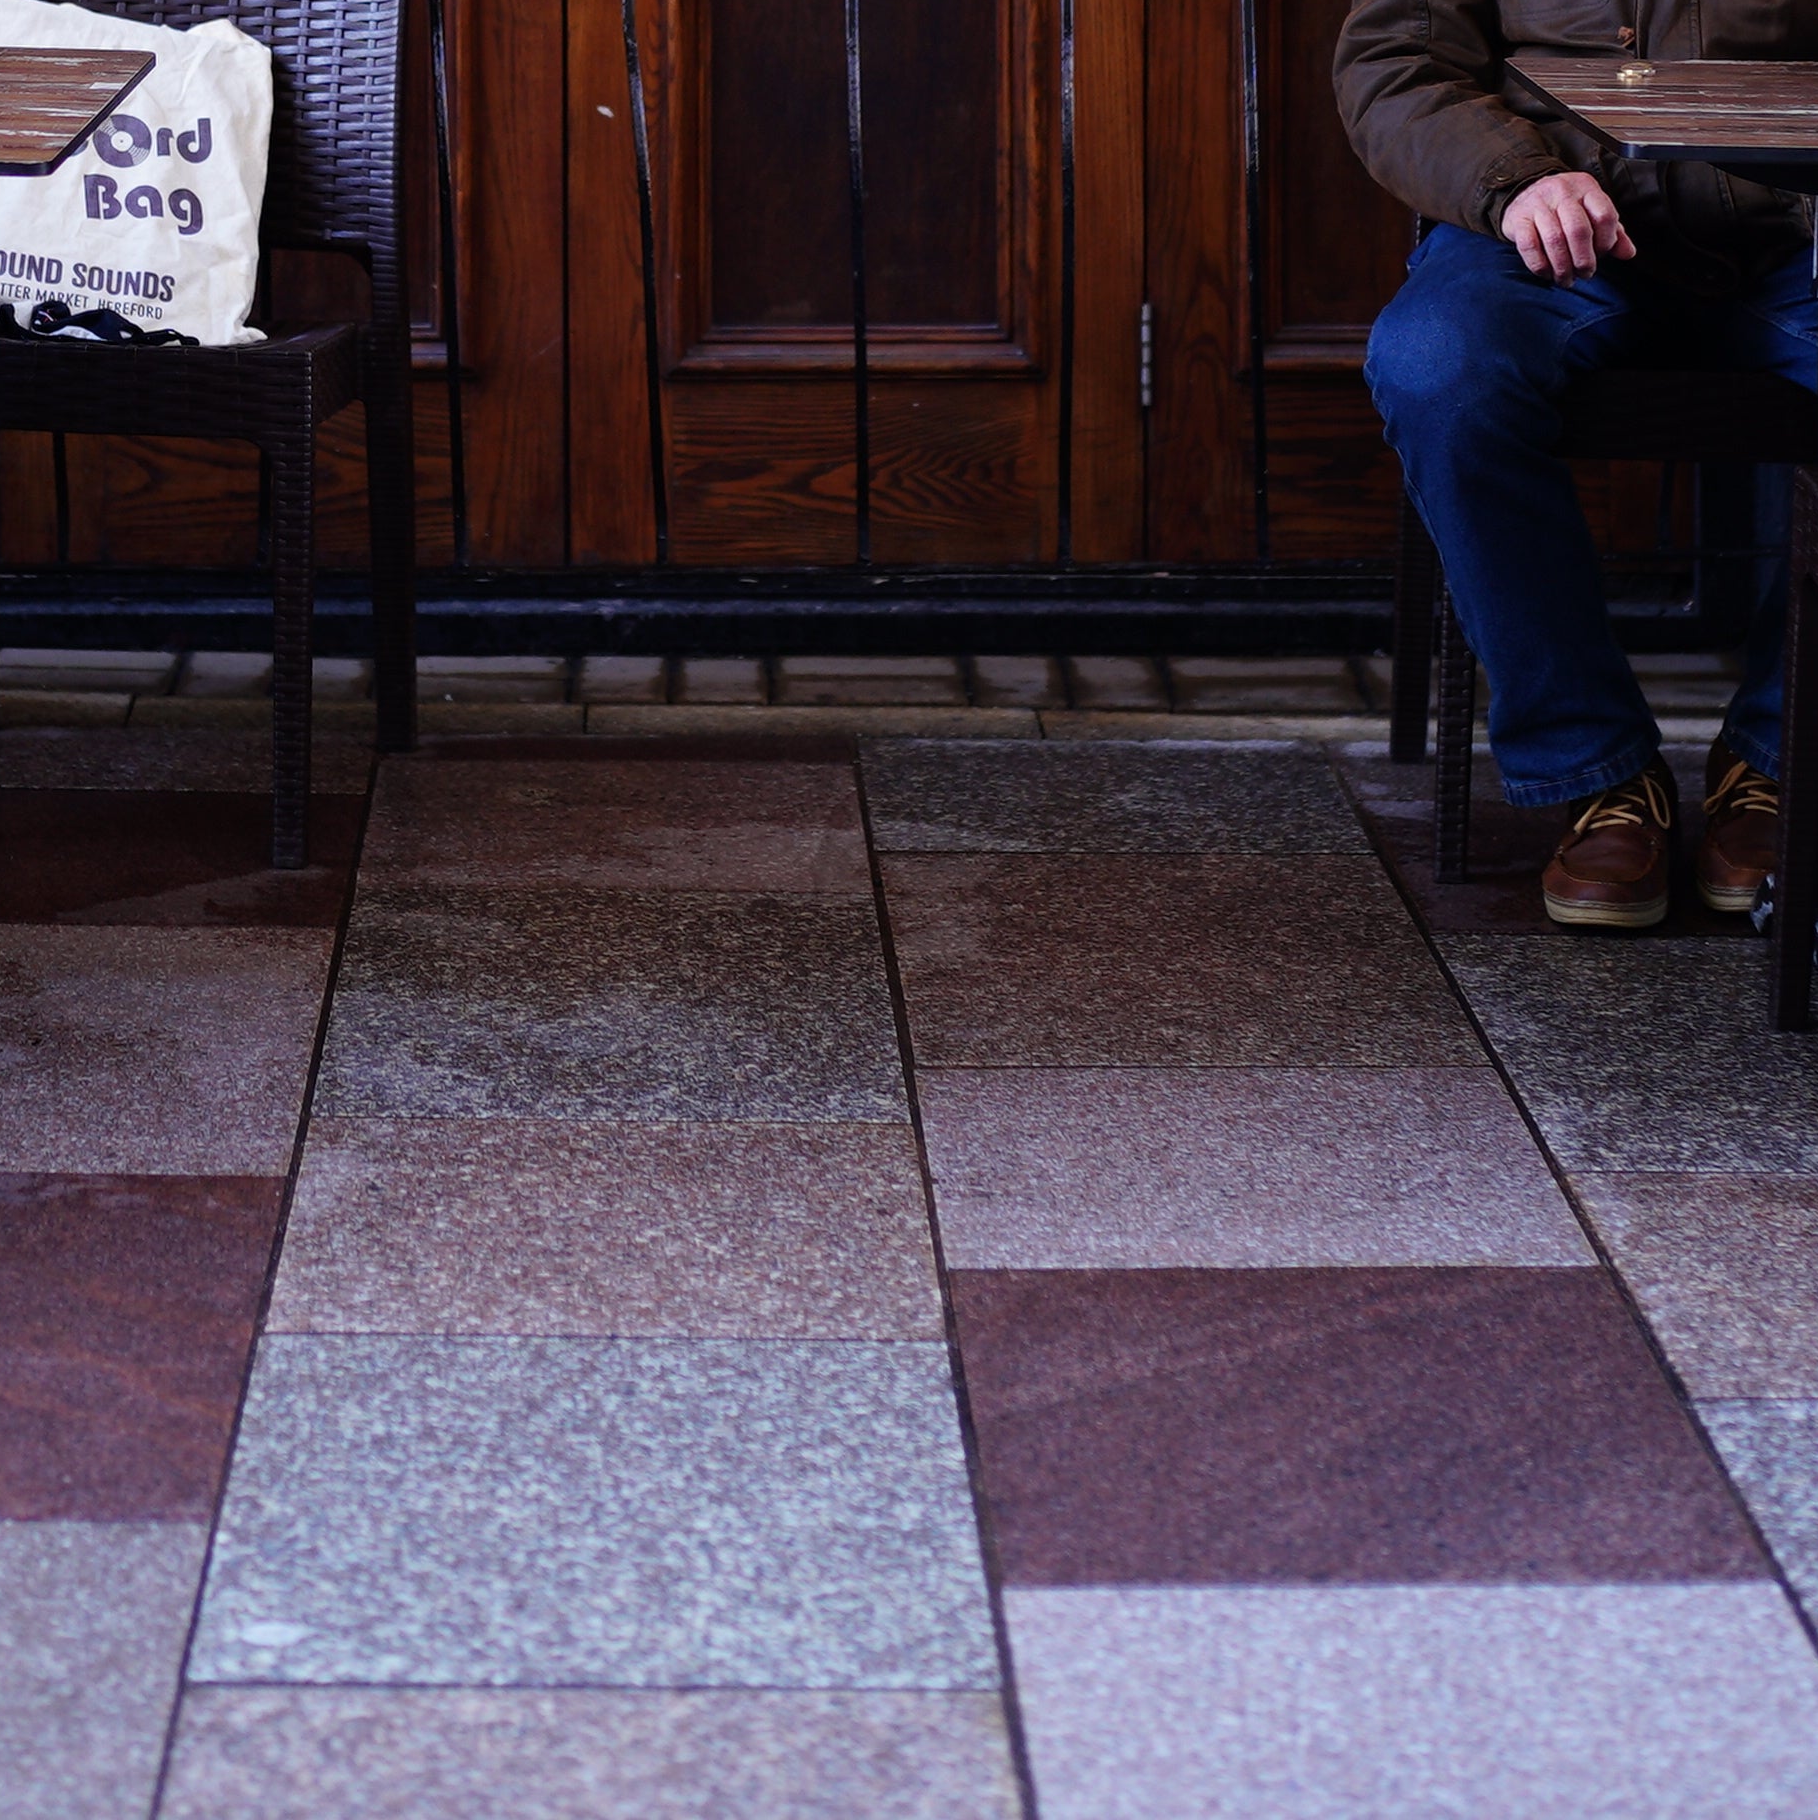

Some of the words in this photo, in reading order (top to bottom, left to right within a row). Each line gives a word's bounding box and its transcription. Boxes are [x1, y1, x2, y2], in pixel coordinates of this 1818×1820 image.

[83, 173, 204, 236] Bag
[71, 263, 176, 303] SOUNDS
[35, 288, 90, 309] MARKET
[97, 299, 163, 321] HEREFORD
